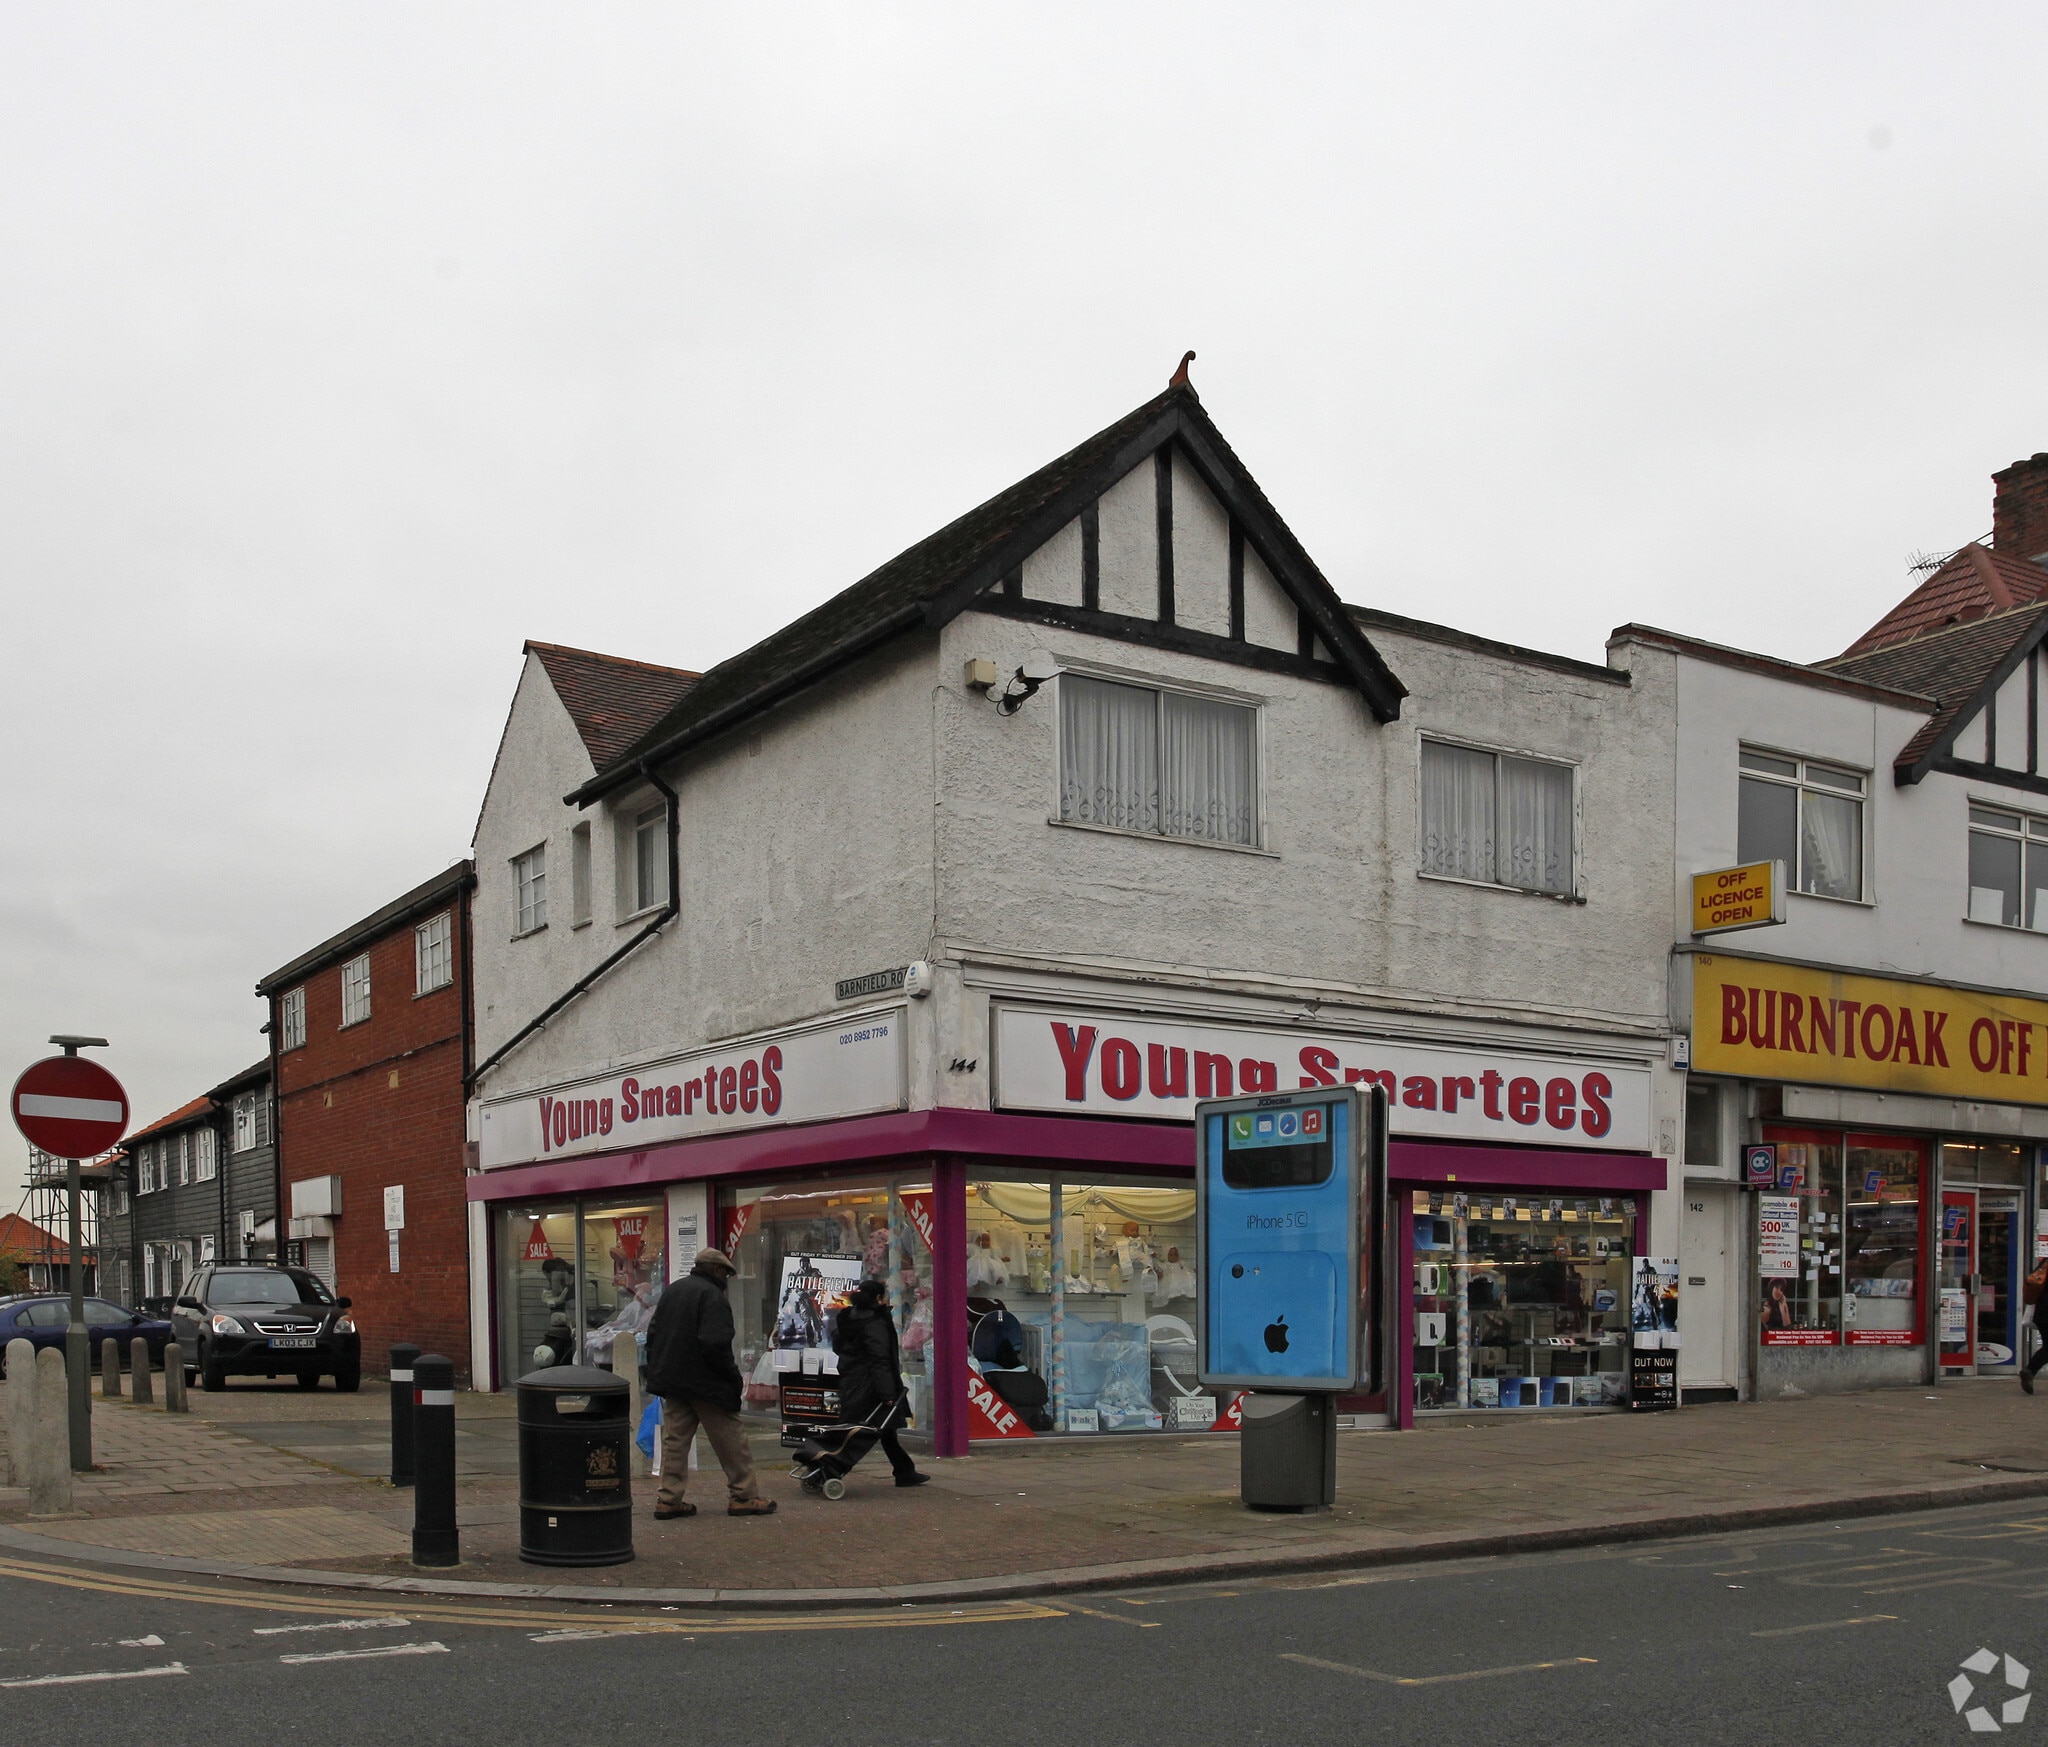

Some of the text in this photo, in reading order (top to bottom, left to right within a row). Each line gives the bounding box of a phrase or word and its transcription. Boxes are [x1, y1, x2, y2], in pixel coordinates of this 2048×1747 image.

[1717, 871, 1747, 889] OFF
[1701, 887, 1763, 909] LICENCE
[1711, 906, 1752, 924] OPEN
[1699, 957, 1712, 966] 140
[839, 974, 887, 997] BARNFIELD
[840, 1026, 888, 1045] 020 8952 7796
[1721, 983, 1950, 1068] BURNTOAK
[1969, 1017, 2033, 1077] OFF
[948, 1058, 978, 1073] 144
[1050, 1021, 1278, 1102] Young
[539, 1094, 614, 1152] Young
[1780, 1166, 1803, 1196] GT
[1864, 1170, 1888, 1200] GT
[1689, 1203, 1704, 1213] 142
[620, 1219, 642, 1235] SALE
[911, 1200, 934, 1250] SAL
[1247, 1214, 1283, 1229] iPhone
[1761, 1221, 1781, 1233] 500
[726, 1209, 747, 1260] SALE
[530, 1244, 548, 1258] SALE
[787, 1275, 854, 1292] BATTLEFIELD
[1634, 1358, 1674, 1367] OUT NOW
[968, 1377, 1018, 1435] SALE
